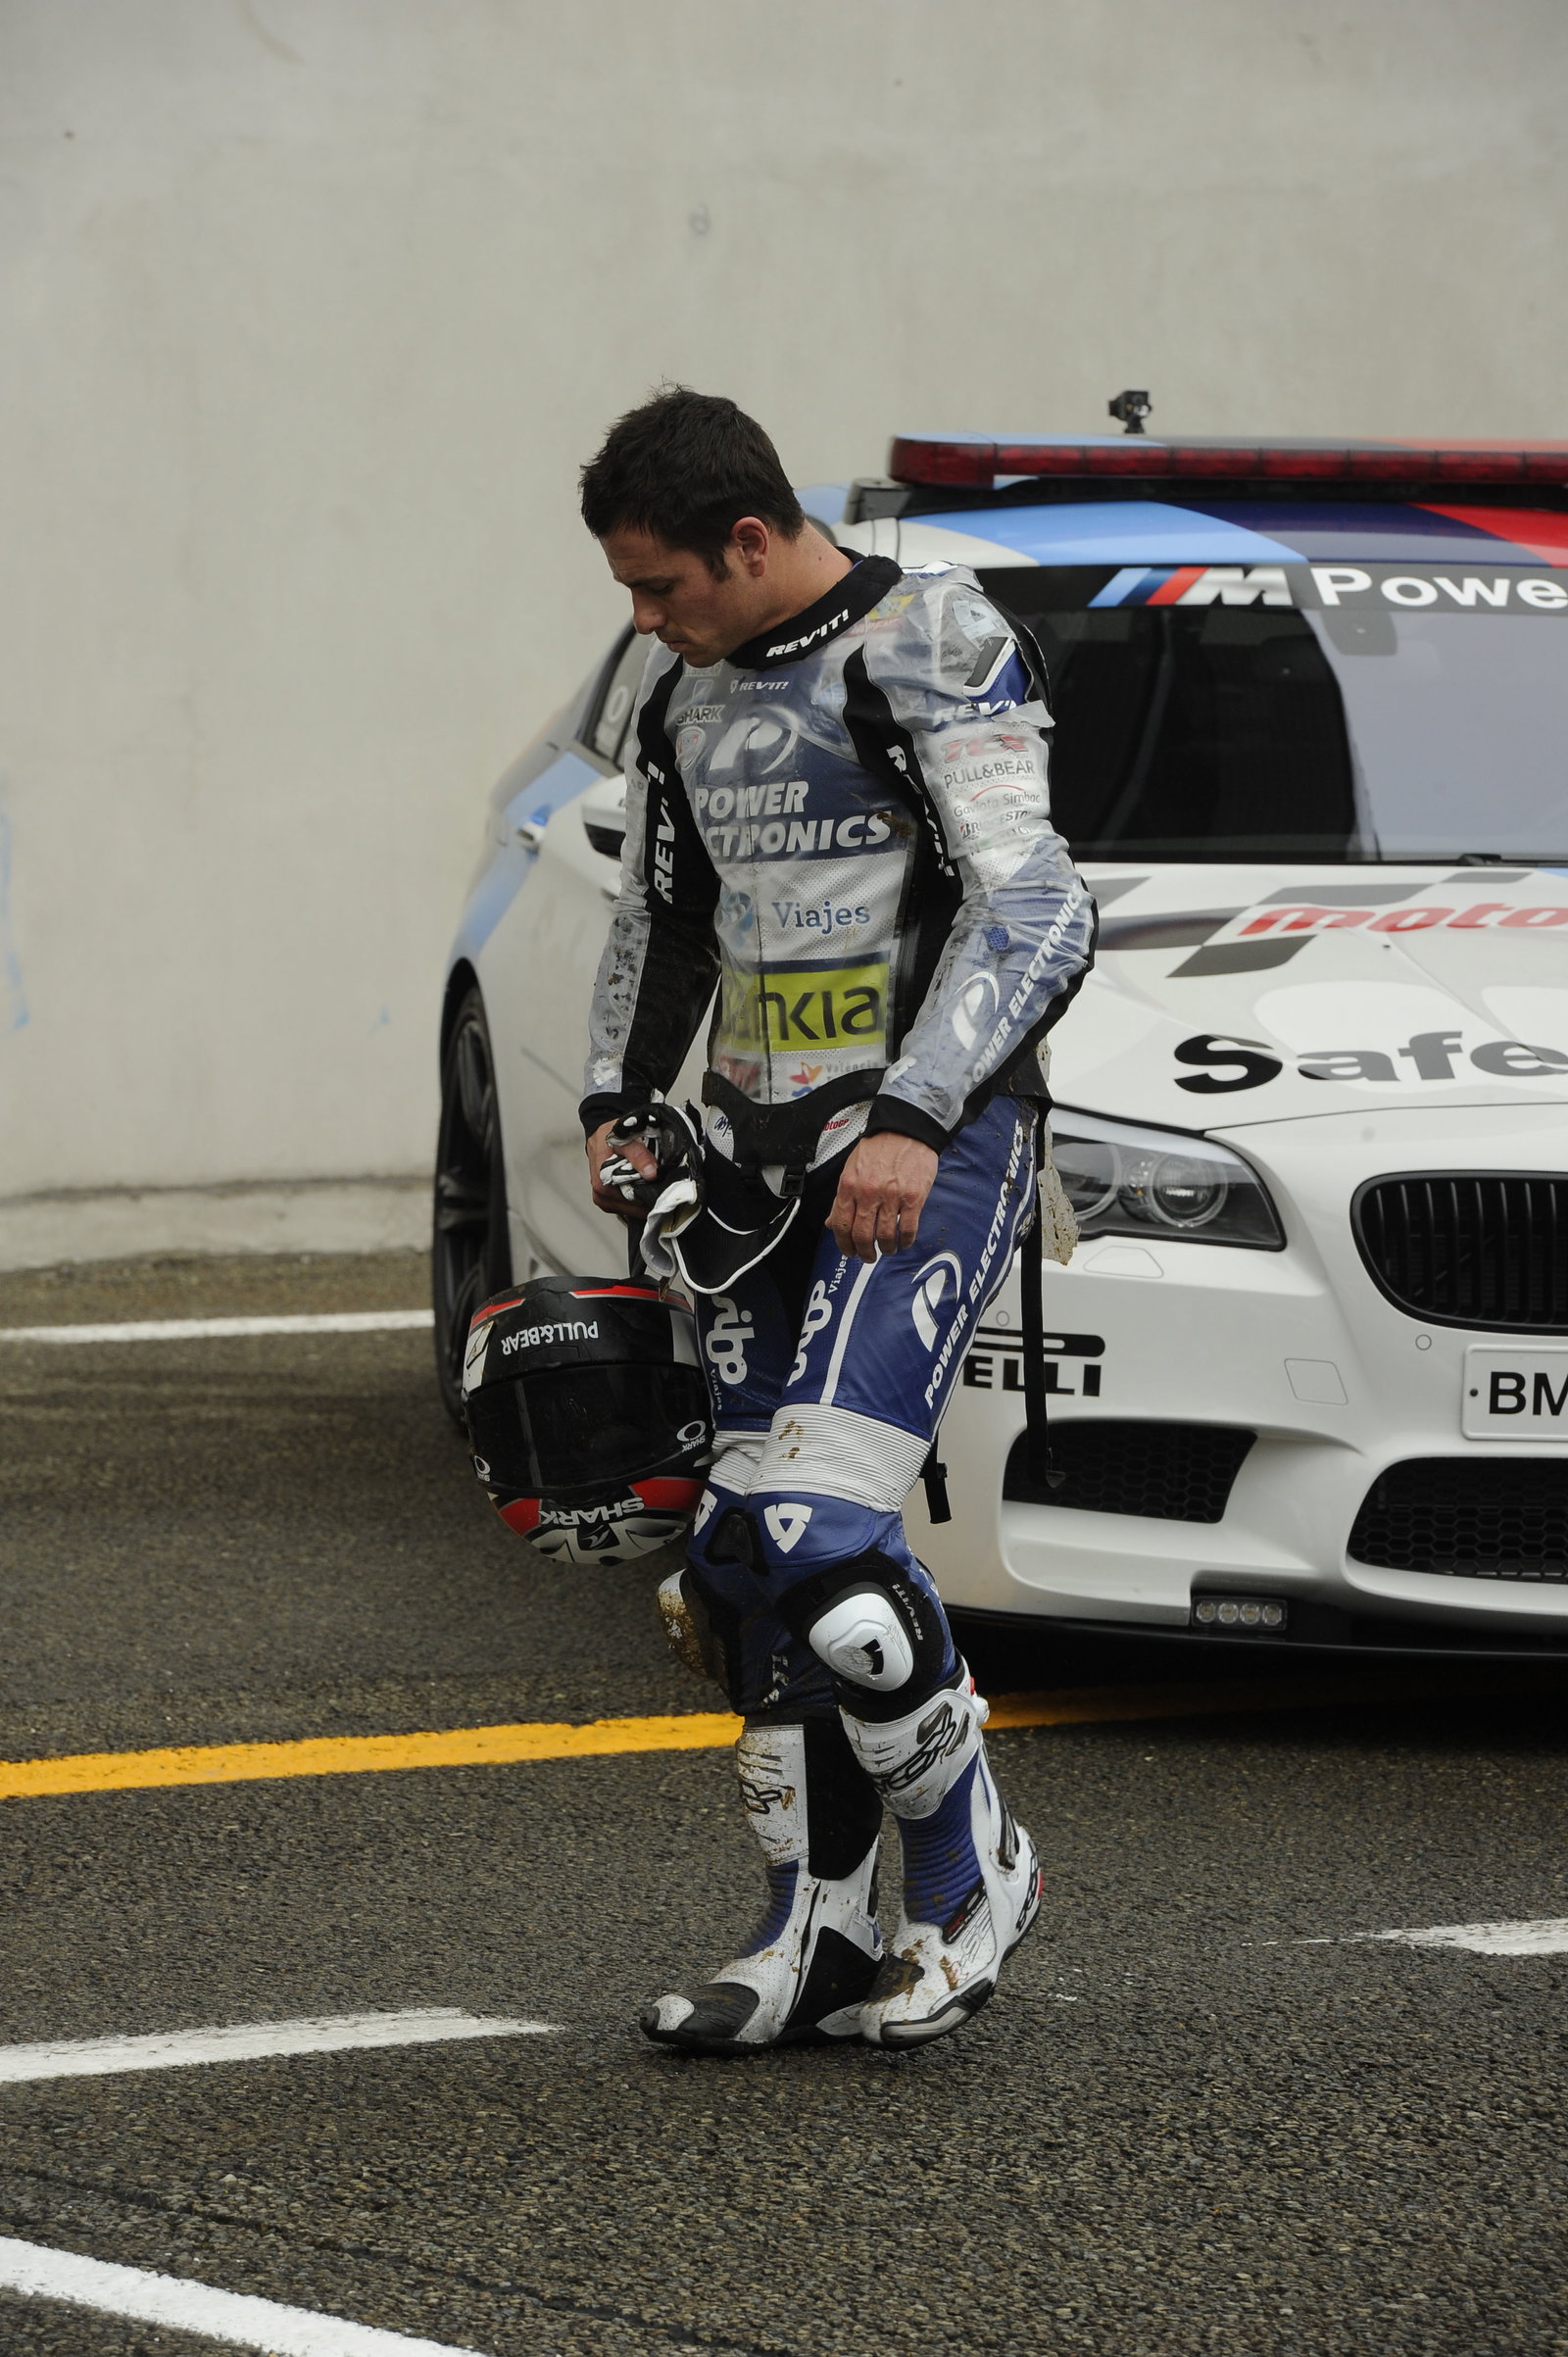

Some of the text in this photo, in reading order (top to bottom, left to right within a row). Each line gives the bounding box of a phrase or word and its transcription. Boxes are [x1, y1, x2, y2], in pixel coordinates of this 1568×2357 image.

[1309, 567, 1568, 609] Powe
[765, 609, 849, 658] REV'IT!
[676, 704, 726, 725] SHARK
[933, 699, 1017, 726] REV'
[944, 761, 1035, 789] PULL&BEAR
[695, 780, 809, 819] POWER
[699, 810, 892, 858] CTRONICS
[771, 900, 871, 935] Viajes
[1237, 903, 1568, 937] moto
[755, 986, 881, 1042] nkia
[1174, 1030, 1568, 1095] Safe
[501, 1320, 599, 1355] PULL&BEAR
[924, 1303, 968, 1409] POWER
[963, 1354, 1102, 1397] ELLI
[1489, 1370, 1568, 1417] BM
[538, 1497, 645, 1526] SHARK
